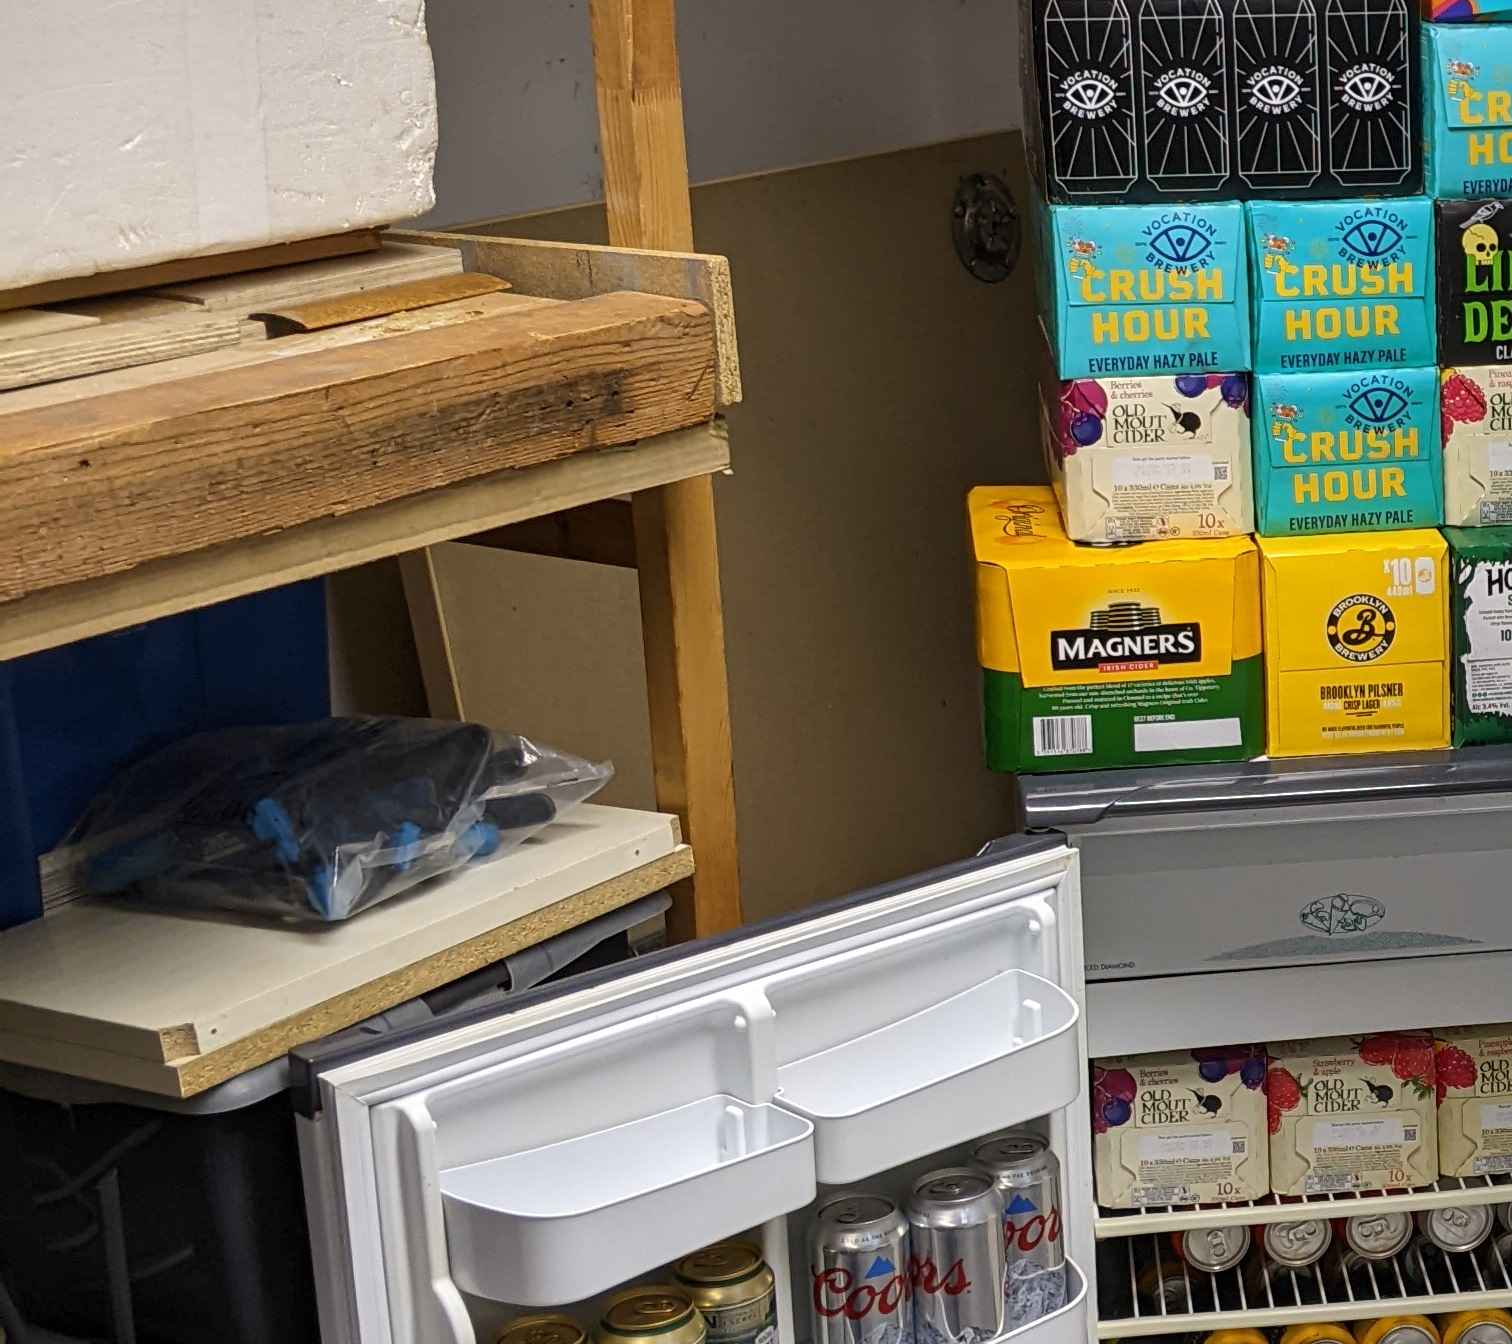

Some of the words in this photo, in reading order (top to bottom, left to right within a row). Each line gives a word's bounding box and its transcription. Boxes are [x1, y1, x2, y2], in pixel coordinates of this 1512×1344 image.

[1059, 69, 1120, 91] VOCATION
[1154, 67, 1212, 89] VOCATION
[1246, 65, 1305, 87] VOCATION
[1337, 63, 1396, 83] VOCATION
[1062, 100, 1118, 121] BREWERY
[1156, 97, 1212, 118] BREWERY
[1248, 95, 1303, 116] BREWERY
[1340, 92, 1394, 113] BREWERY
[1141, 211, 1218, 238] VOCATION
[1333, 207, 1409, 233] VOCATION
[1145, 250, 1217, 277] BREWERY
[1337, 244, 1408, 272] BREWERY
[1080, 268, 1225, 304] CRUSH
[1274, 262, 1414, 298] CRUSH
[1091, 306, 1212, 345] HOUR
[1284, 304, 1400, 342] HOUR
[1088, 354, 1151, 374] EVERYDAY
[1152, 352, 1187, 370] HAZY
[1188, 350, 1219, 368] PALE
[1280, 351, 1341, 370] EVERYDAY
[1343, 349, 1376, 366] HAZY
[1378, 347, 1408, 363] PALE
[1110, 380, 1143, 390] Berries
[1119, 390, 1153, 400] cherries
[1342, 374, 1415, 399] VOCATION
[1112, 403, 1146, 418] OLD
[1114, 414, 1168, 430] MOUT
[1344, 411, 1414, 436] BREWERY
[1113, 429, 1166, 444] CIDER
[1281, 428, 1419, 465] CRUSH
[1294, 467, 1409, 505] HOUR
[1289, 512, 1349, 531] EVERYDAY
[1350, 511, 1385, 528] HAZY
[1386, 509, 1414, 525] PALE
[1332, 594, 1389, 618] BROOKLYN
[1057, 631, 1196, 662] MAGNERS
[1334, 640, 1389, 662] BREWERY
[1103, 663, 1127, 672] IRISH
[1129, 662, 1155, 671] CIDER
[1320, 683, 1366, 701] BROOKLYN
[1367, 682, 1404, 698] PILSNER
[1343, 700, 1361, 711] CRISP
[1361, 699, 1381, 709] LAGER
[1139, 1068, 1170, 1078] Berries
[1479, 1059, 1510, 1073] OLD
[1140, 1087, 1172, 1103] OLD
[1313, 1077, 1345, 1093] OLD
[1315, 1086, 1363, 1102] MOUT
[1142, 1097, 1191, 1114] MOUT
[1313, 1098, 1361, 1114] CIDER
[1140, 1110, 1191, 1126] CIDER
